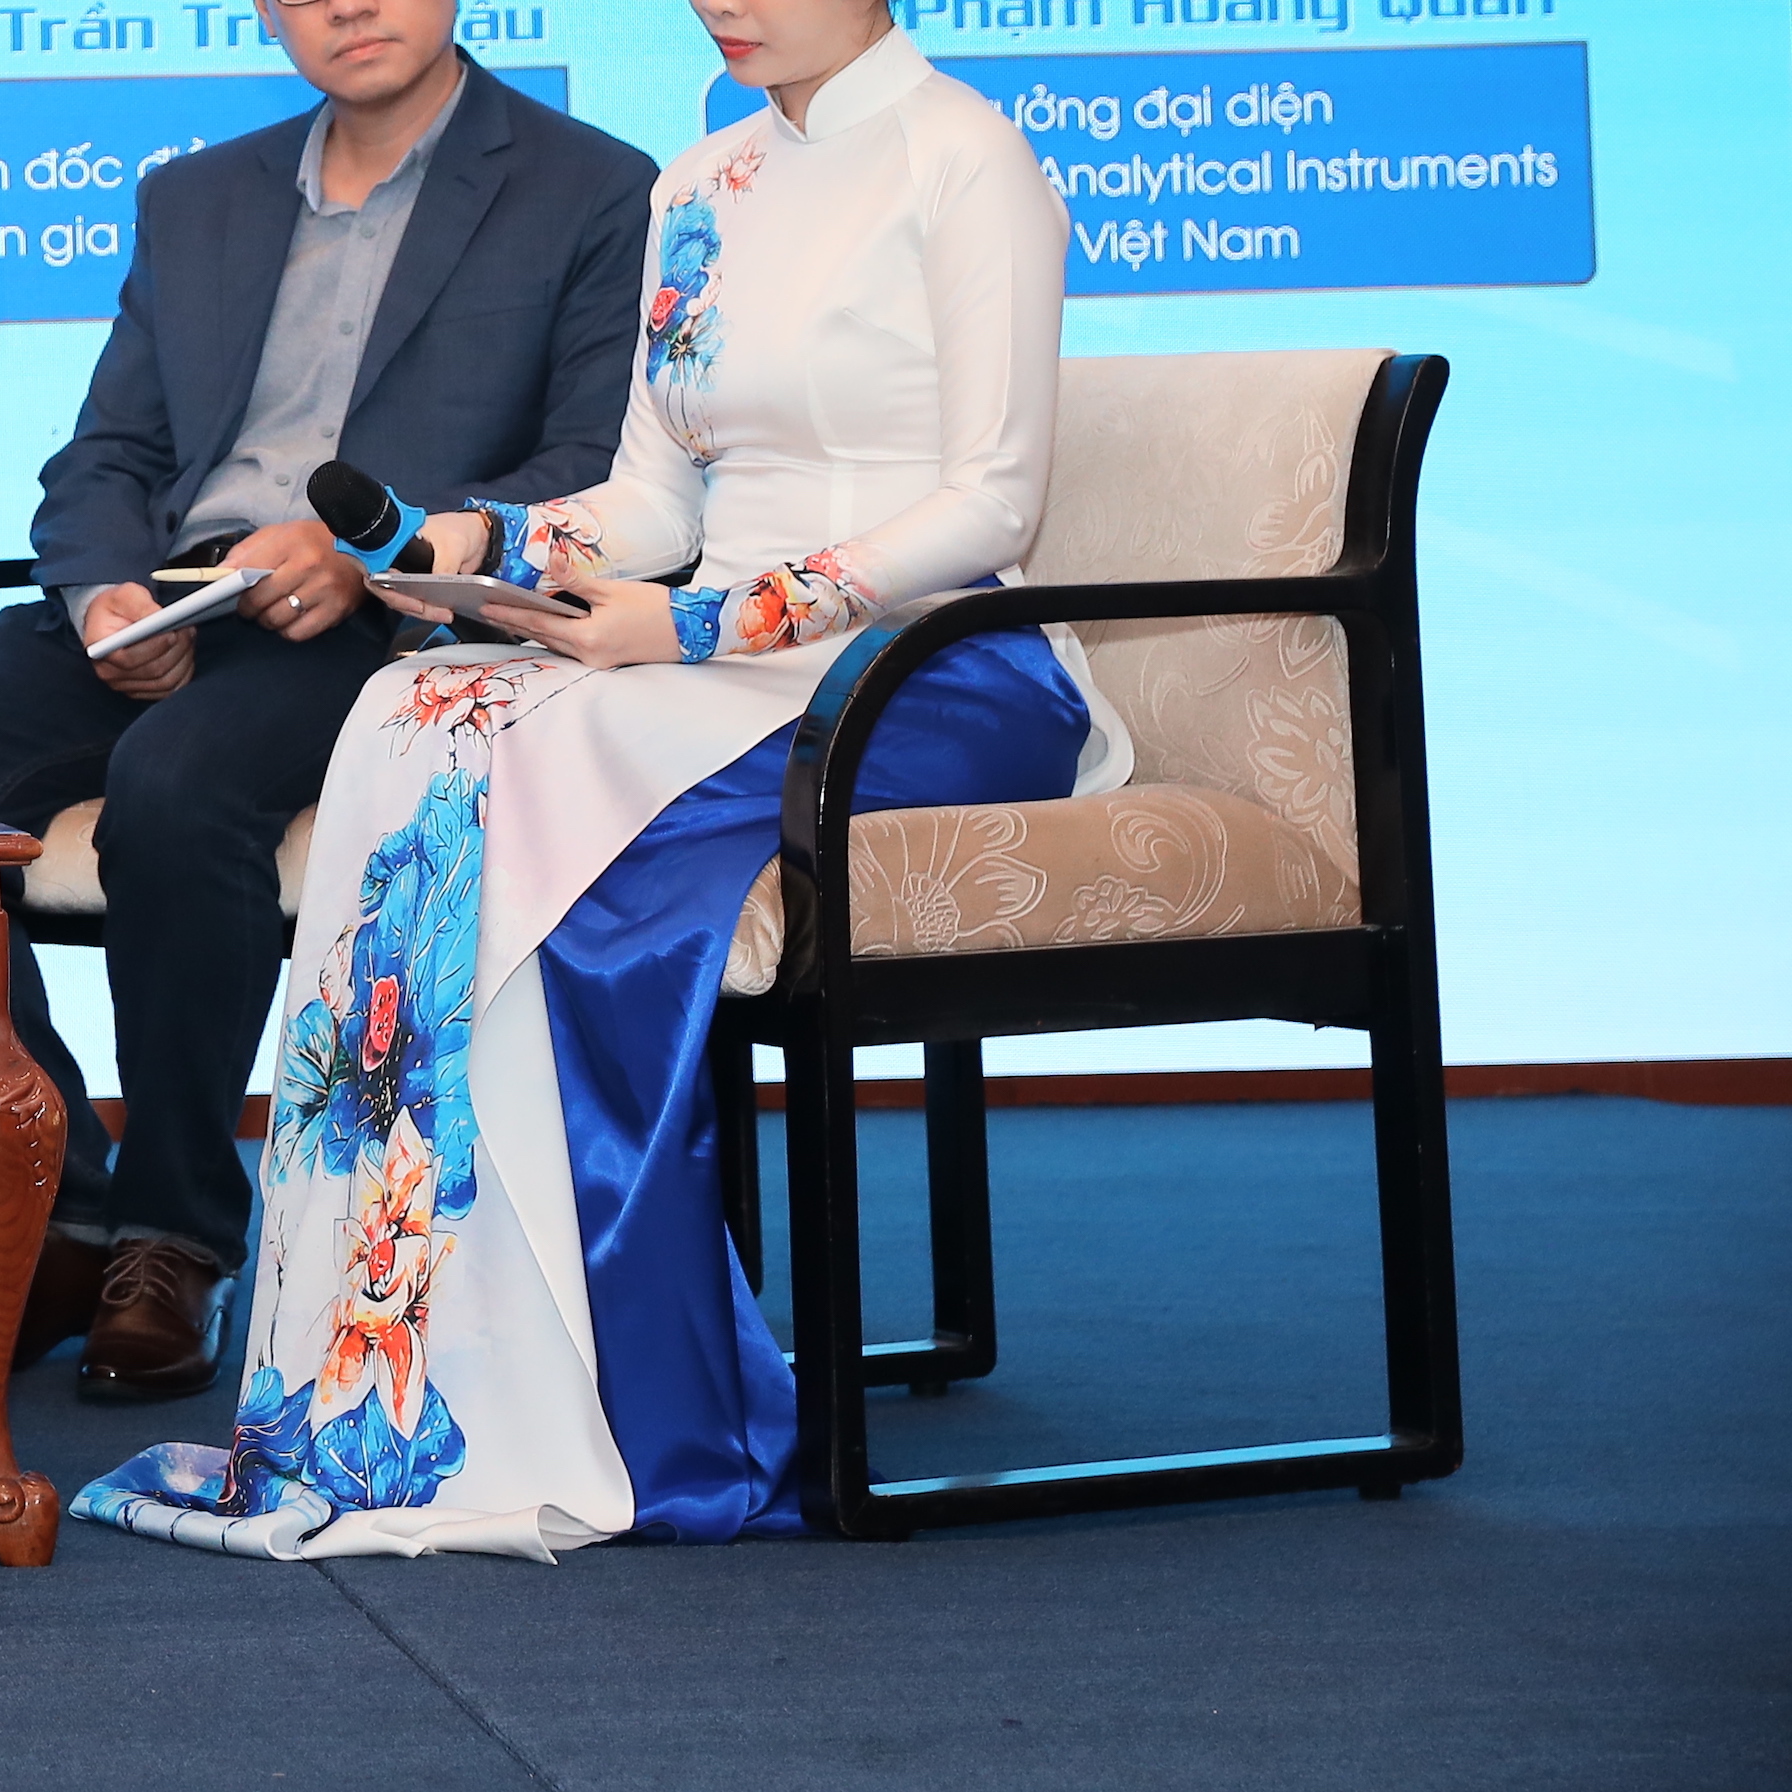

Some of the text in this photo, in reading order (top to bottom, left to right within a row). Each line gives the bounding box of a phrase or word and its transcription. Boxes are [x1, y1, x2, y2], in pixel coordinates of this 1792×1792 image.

[1133, 84, 1212, 137] đại
[1224, 82, 1334, 135] diện
[24, 142, 123, 191] đốc
[1039, 144, 1559, 205] Analytical Instruments
[40, 215, 119, 267] gia
[1074, 218, 1301, 272] Việt Nam
